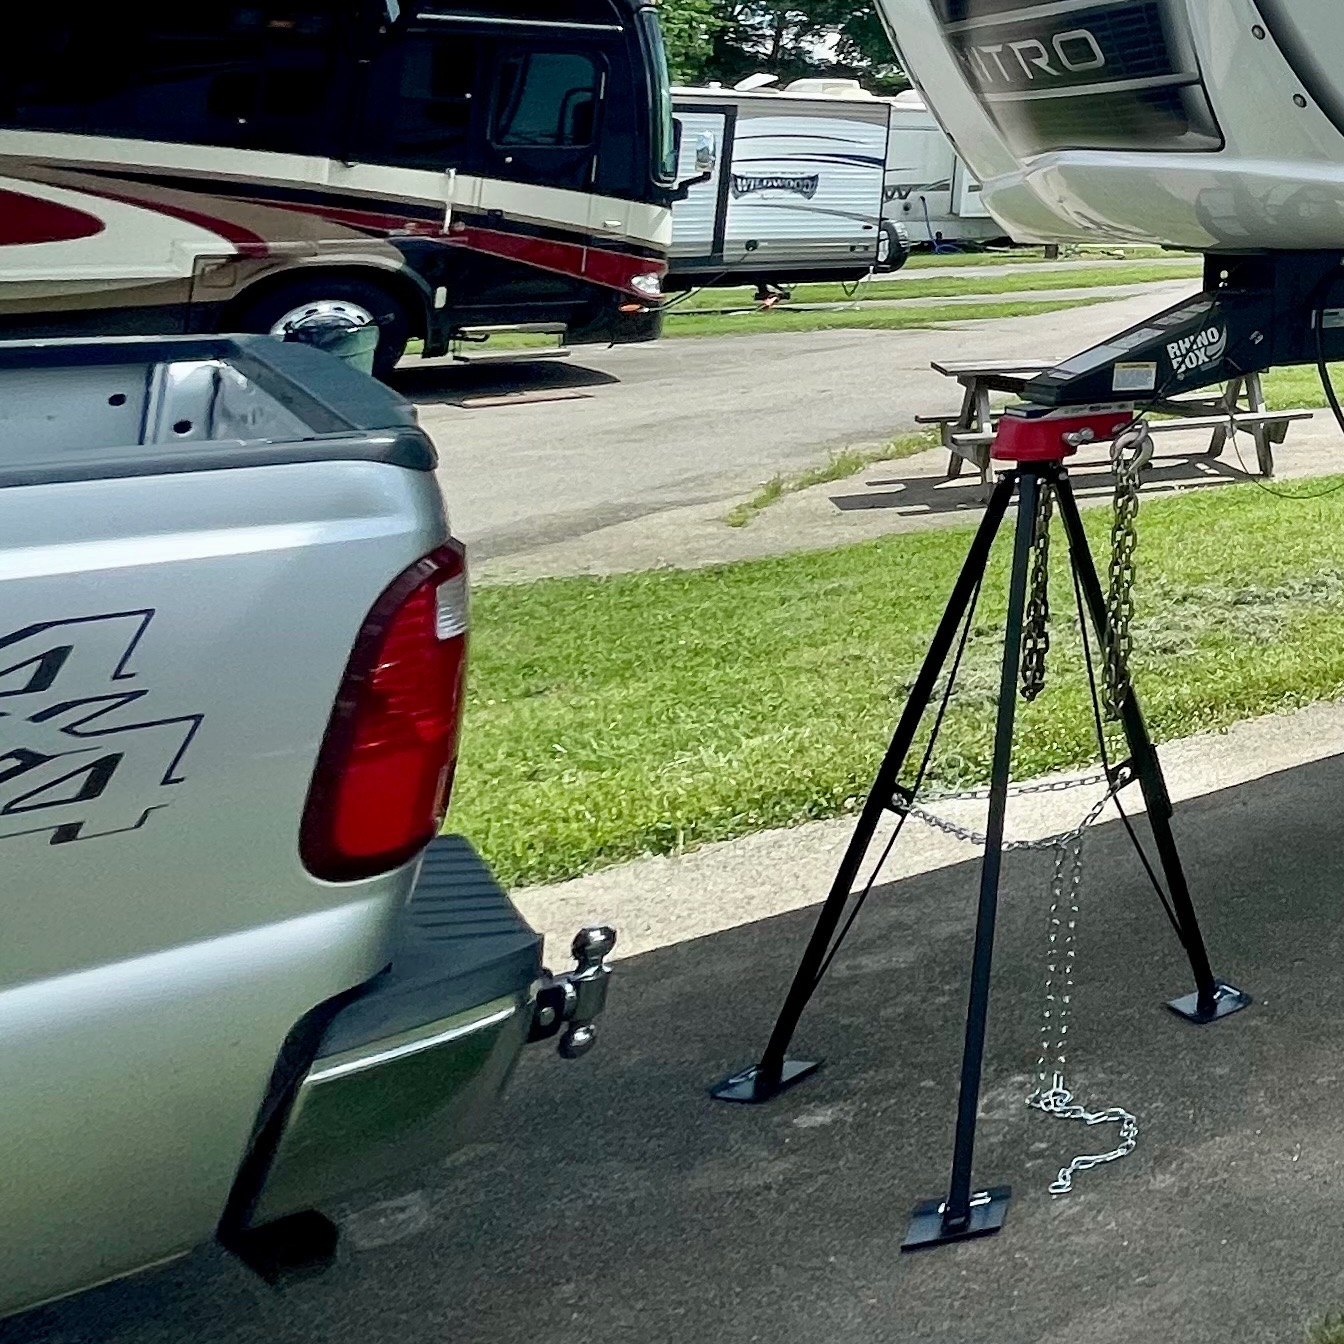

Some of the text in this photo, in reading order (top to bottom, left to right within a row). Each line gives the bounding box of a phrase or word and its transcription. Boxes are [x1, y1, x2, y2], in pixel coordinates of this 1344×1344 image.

[965, 29, 1105, 83] ITRO
[736, 178, 816, 192] WILDWOOD
[1166, 327, 1220, 359] RHINO
[1171, 347, 1210, 374] BOX
